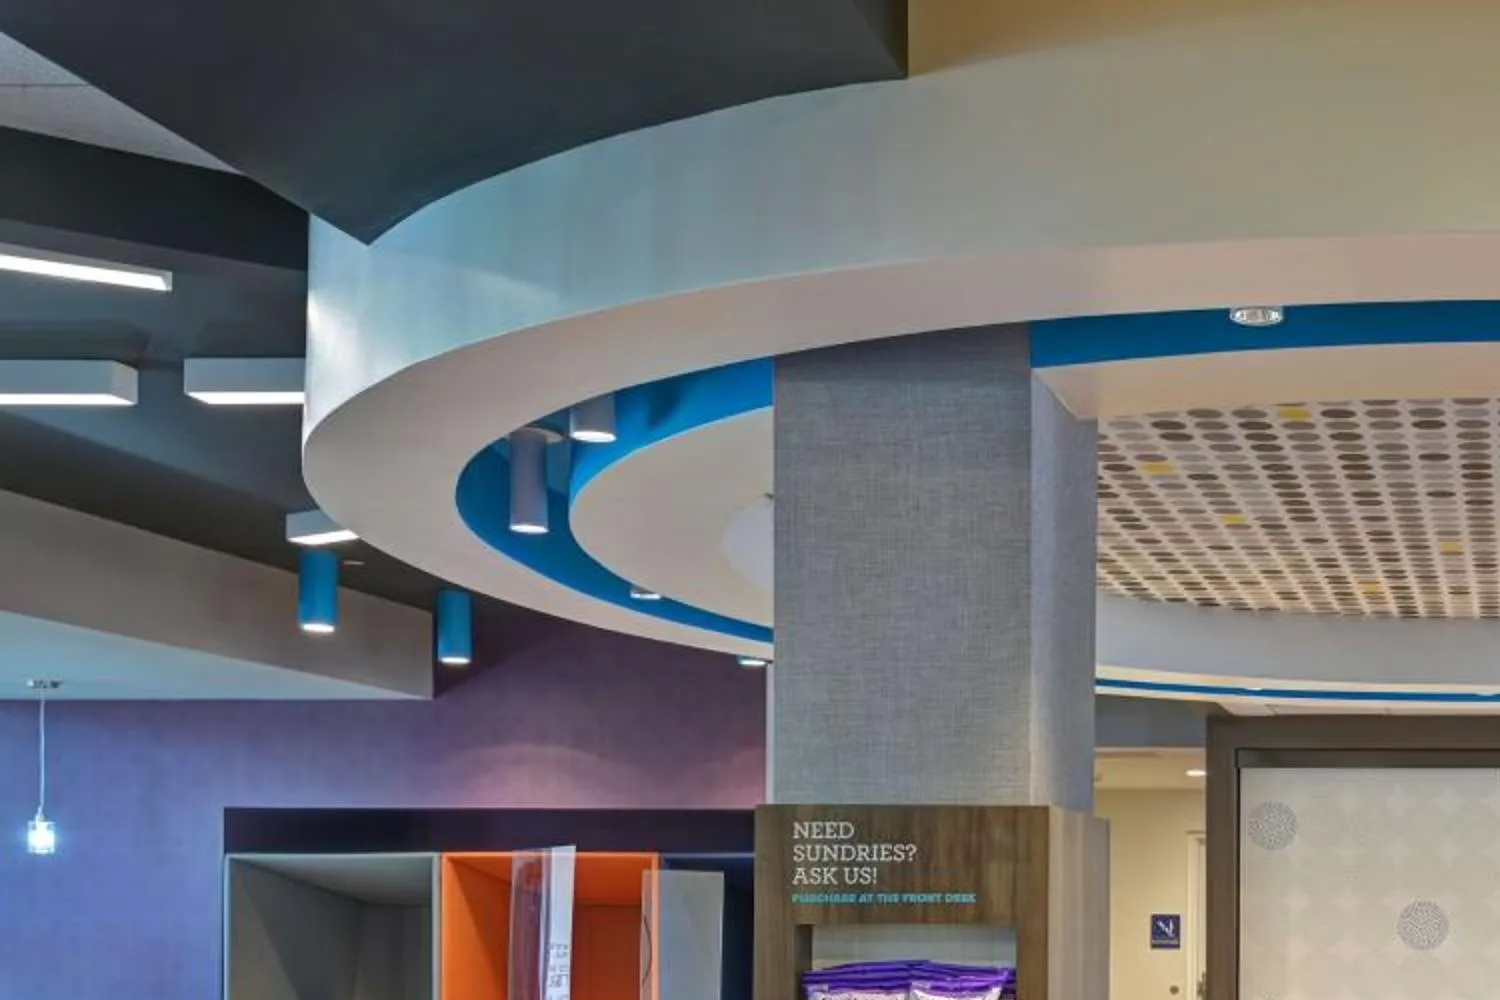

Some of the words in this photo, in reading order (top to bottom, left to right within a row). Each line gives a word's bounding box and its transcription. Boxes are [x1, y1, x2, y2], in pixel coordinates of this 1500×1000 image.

[792, 821, 855, 839] NEED
[793, 844, 917, 862] SUNDRIES?
[792, 867, 838, 885] ASK
[844, 867, 877, 884] US!
